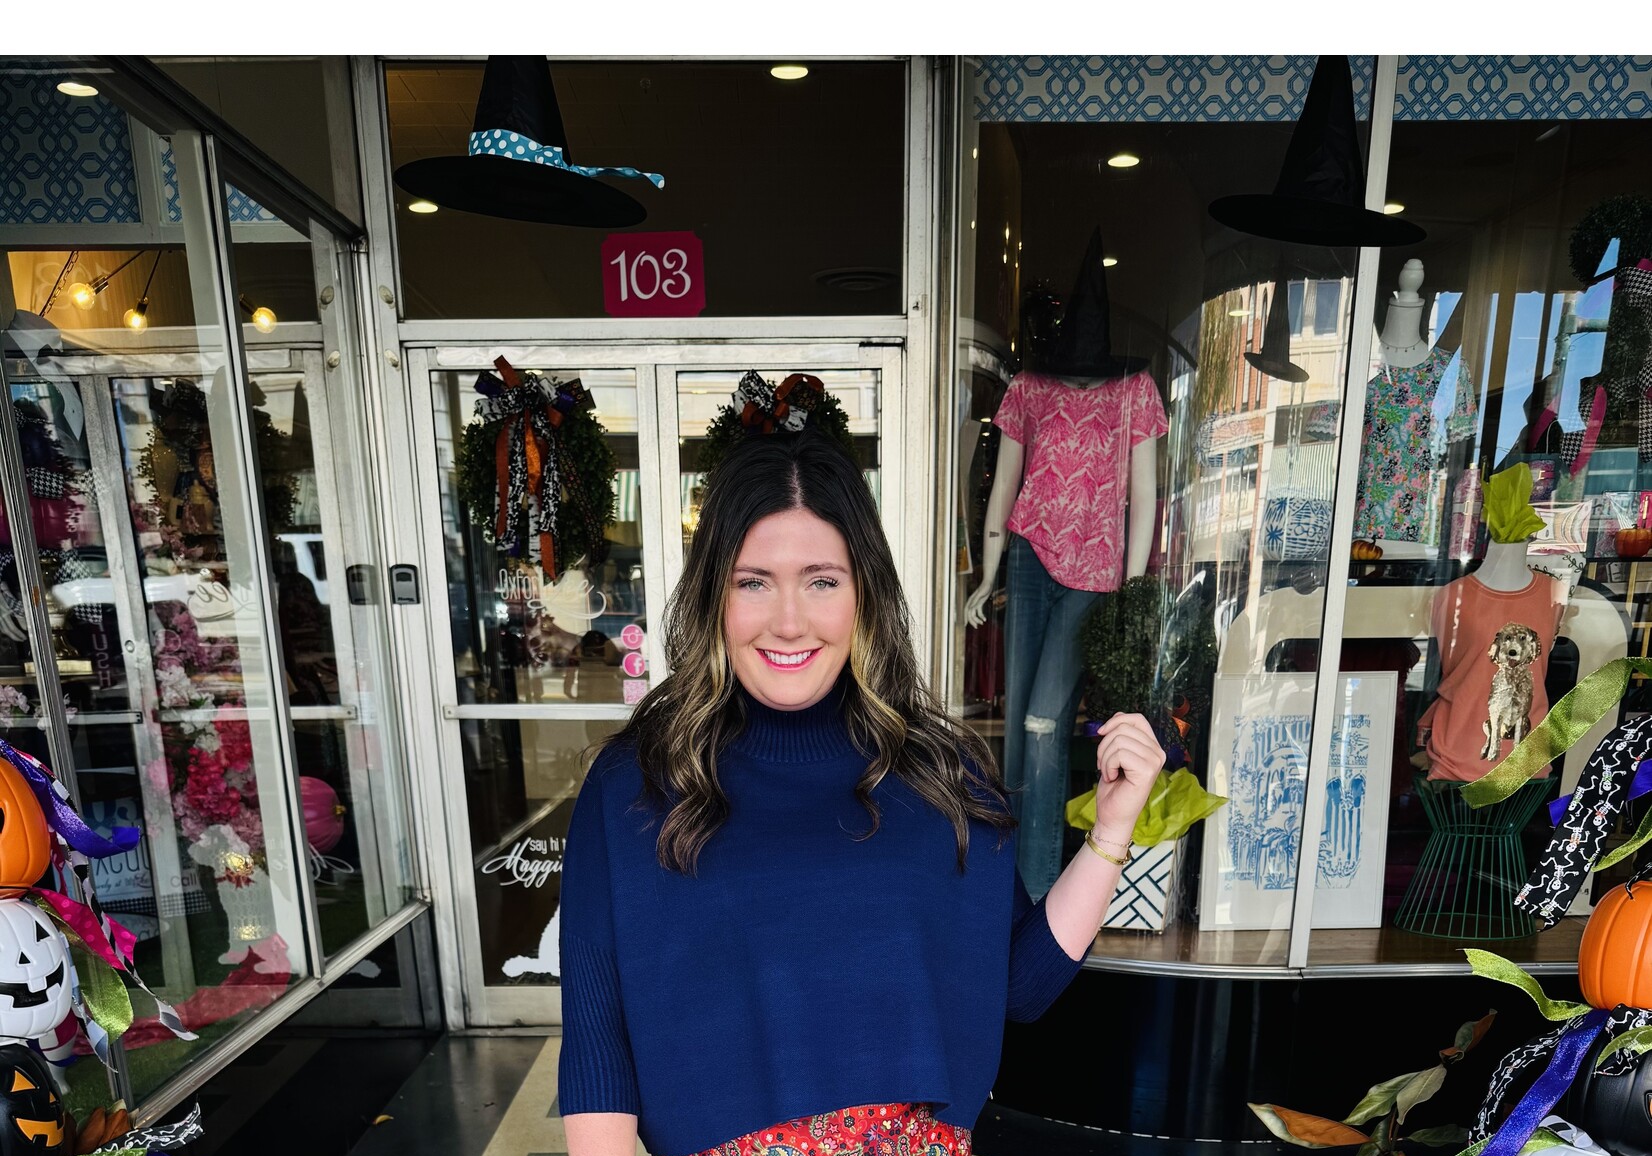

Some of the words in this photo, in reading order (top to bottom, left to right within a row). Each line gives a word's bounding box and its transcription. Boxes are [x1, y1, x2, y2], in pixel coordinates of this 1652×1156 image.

[610, 248, 692, 302] 103
[481, 837, 563, 888] Maggi
[529, 839, 548, 855] say
[549, 837, 560, 851] hi
